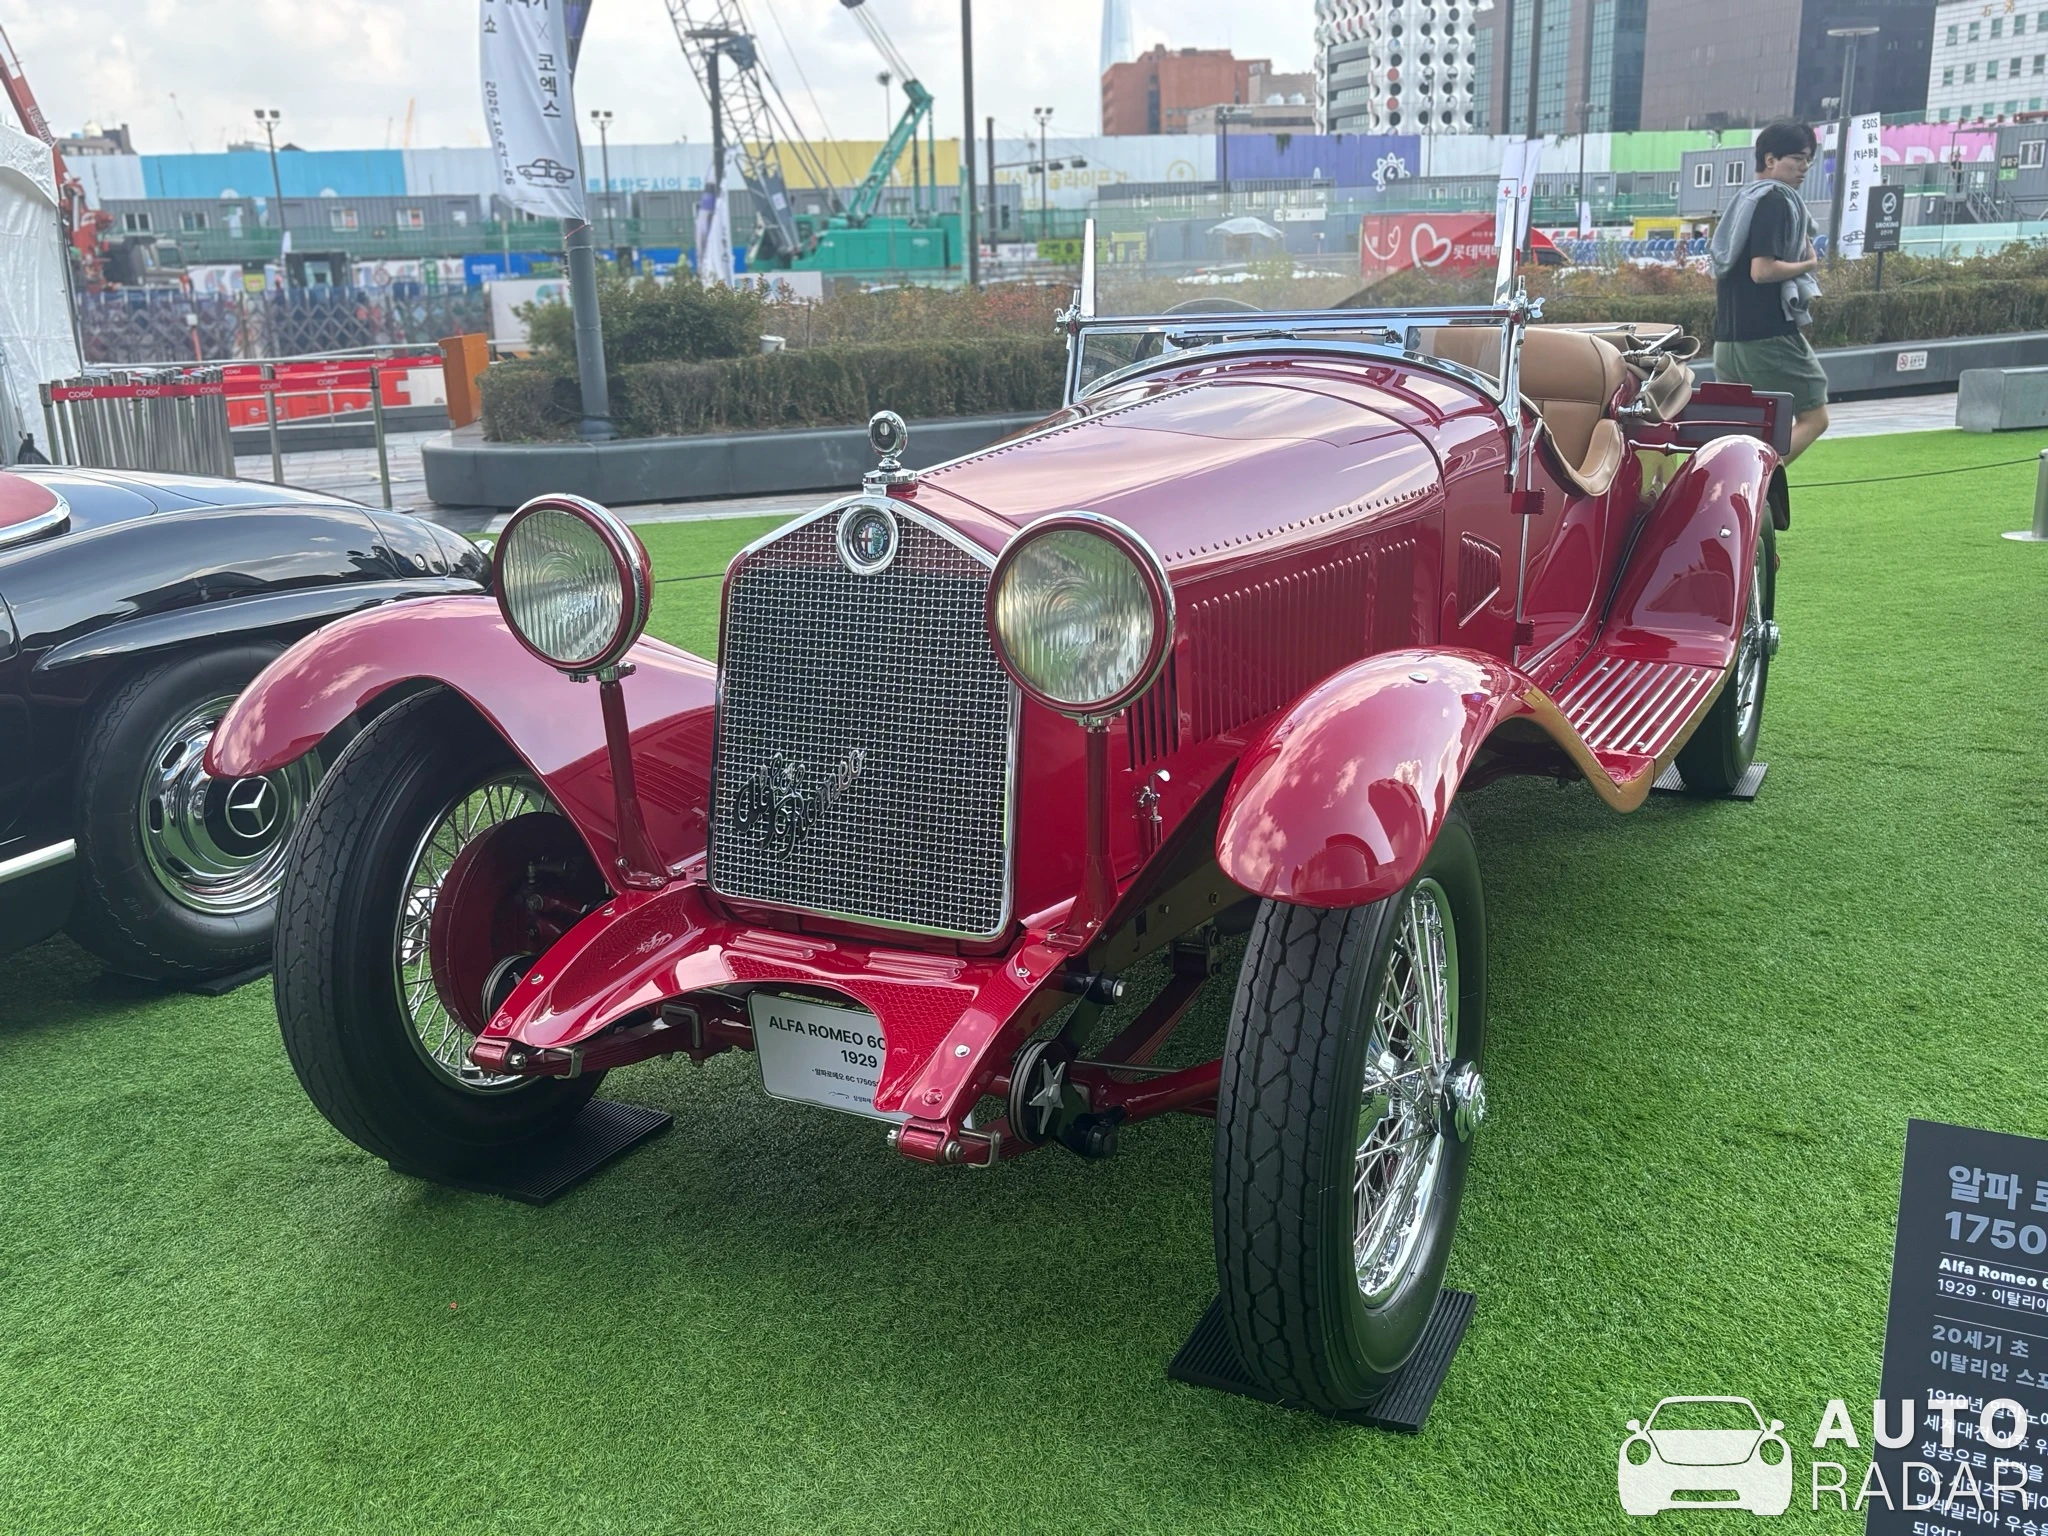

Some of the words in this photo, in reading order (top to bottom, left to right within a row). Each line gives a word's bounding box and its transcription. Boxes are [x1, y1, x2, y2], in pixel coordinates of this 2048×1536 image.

[538, 53, 561, 118] 코엑스
[68, 388, 94, 399] coex
[861, 550, 884, 559] MILANO
[769, 1016, 805, 1034] ALFA
[808, 1023, 863, 1046] ROMEO
[841, 1049, 878, 1068] 1929
[845, 1075, 855, 1083] 6C
[1948, 1165, 2023, 1211] 알파
[1945, 1211, 2047, 1255] 1750
[1939, 1258, 1974, 1276] Alfa
[1978, 1265, 2037, 1287] Romeo
[1937, 1278, 1976, 1297] 1929
[1932, 1324, 2002, 1355] 20세기
[2009, 1340, 2029, 1358] 초
[1930, 1350, 2009, 1382] 이탈리안
[1926, 1388, 1983, 1414] 1910년
[1921, 1440, 1987, 1468] 성공으로
